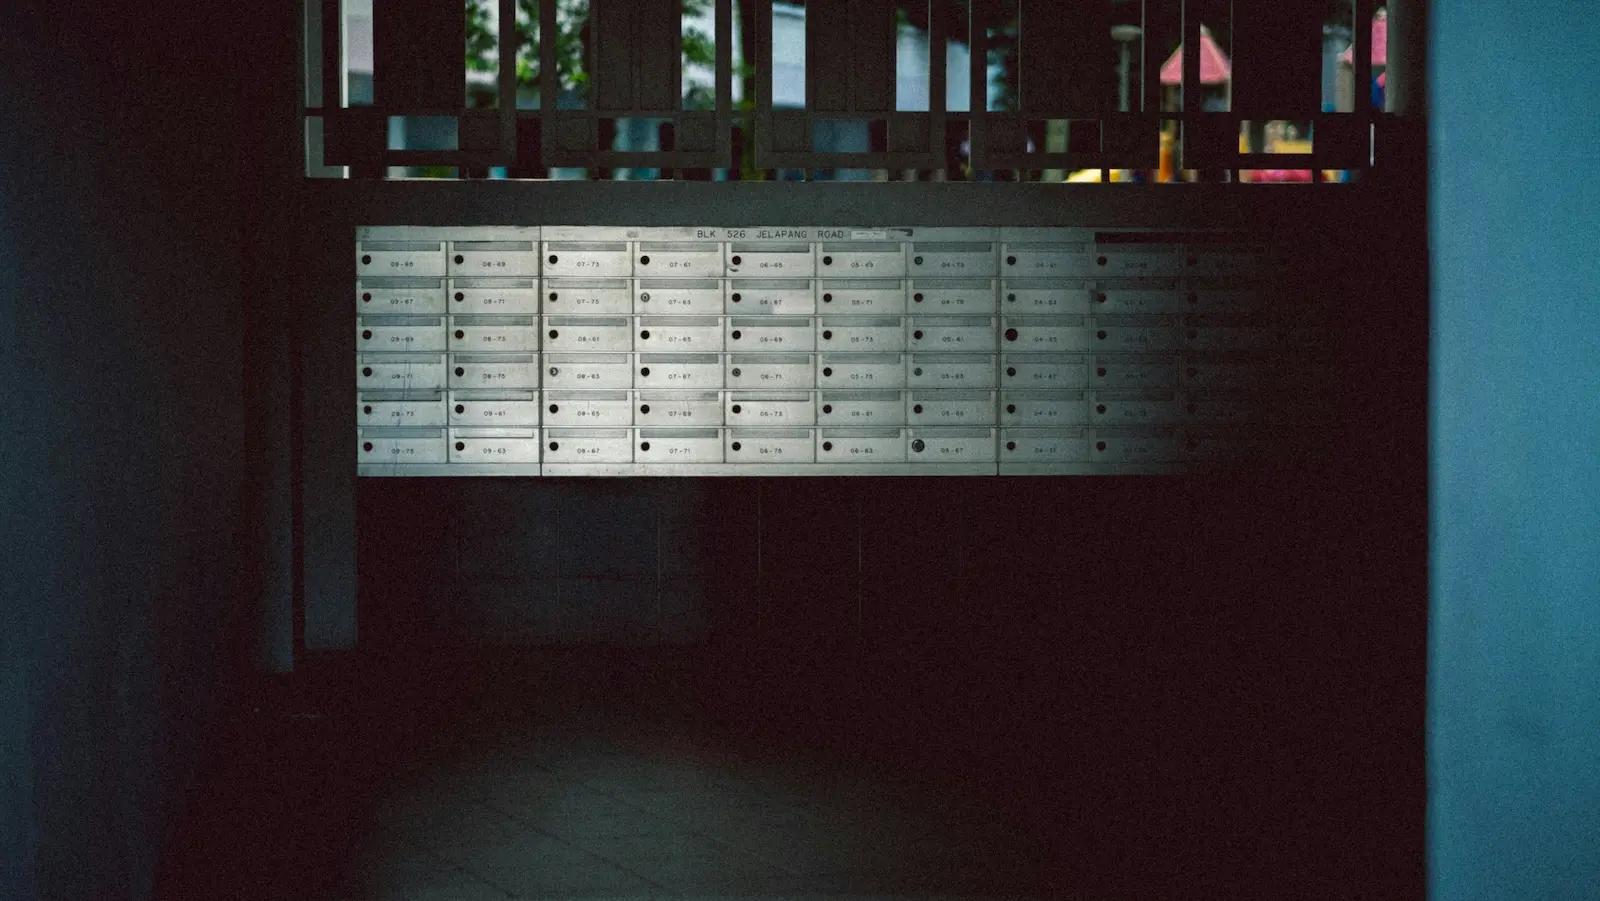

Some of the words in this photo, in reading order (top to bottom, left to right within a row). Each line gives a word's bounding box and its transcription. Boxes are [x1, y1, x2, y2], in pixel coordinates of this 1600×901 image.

[697, 230, 716, 239] BLK
[727, 230, 746, 239] 526
[756, 230, 808, 239] JELAPANG
[817, 230, 844, 239] ROAD
